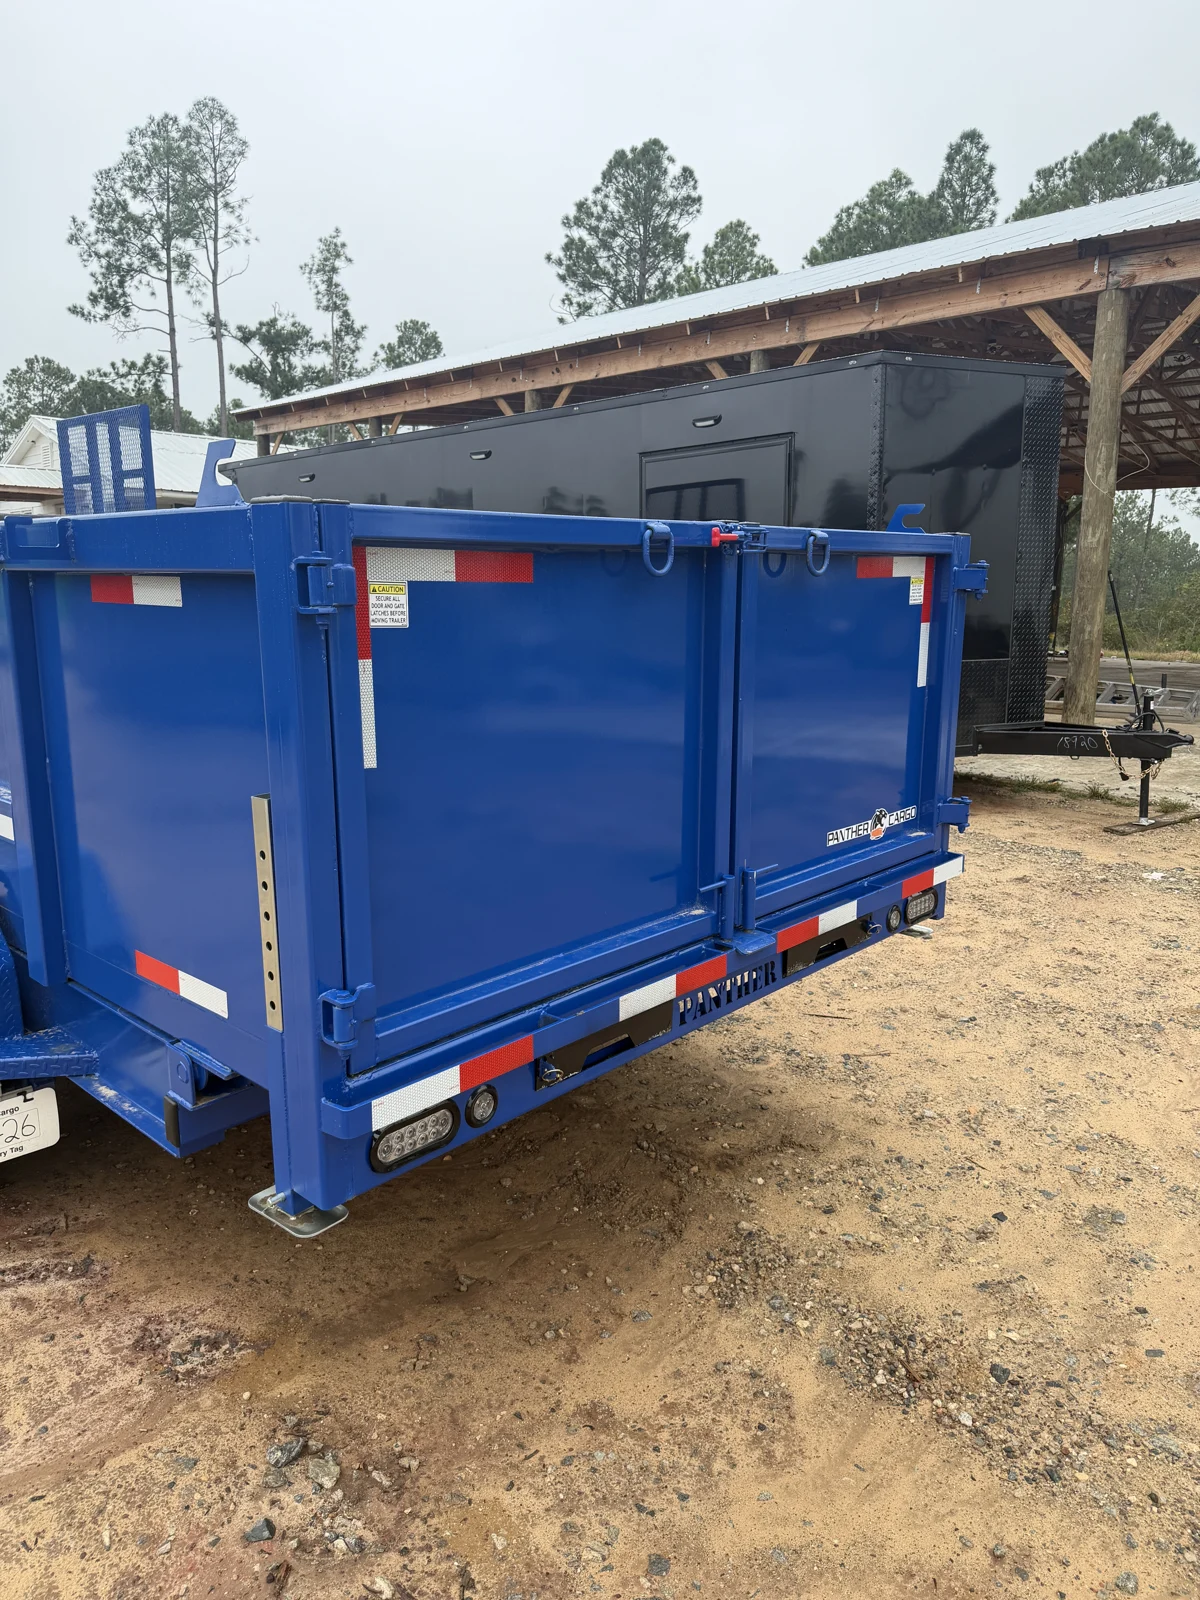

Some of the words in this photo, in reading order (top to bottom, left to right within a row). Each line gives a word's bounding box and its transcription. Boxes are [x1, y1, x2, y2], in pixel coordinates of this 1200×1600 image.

[827, 823, 869, 845] PANTHER
[888, 807, 916, 826] CARGO
[678, 961, 777, 1026] PANTHER
[0, 1106, 20, 1116] argo
[10, 1145, 24, 1154] Tag
